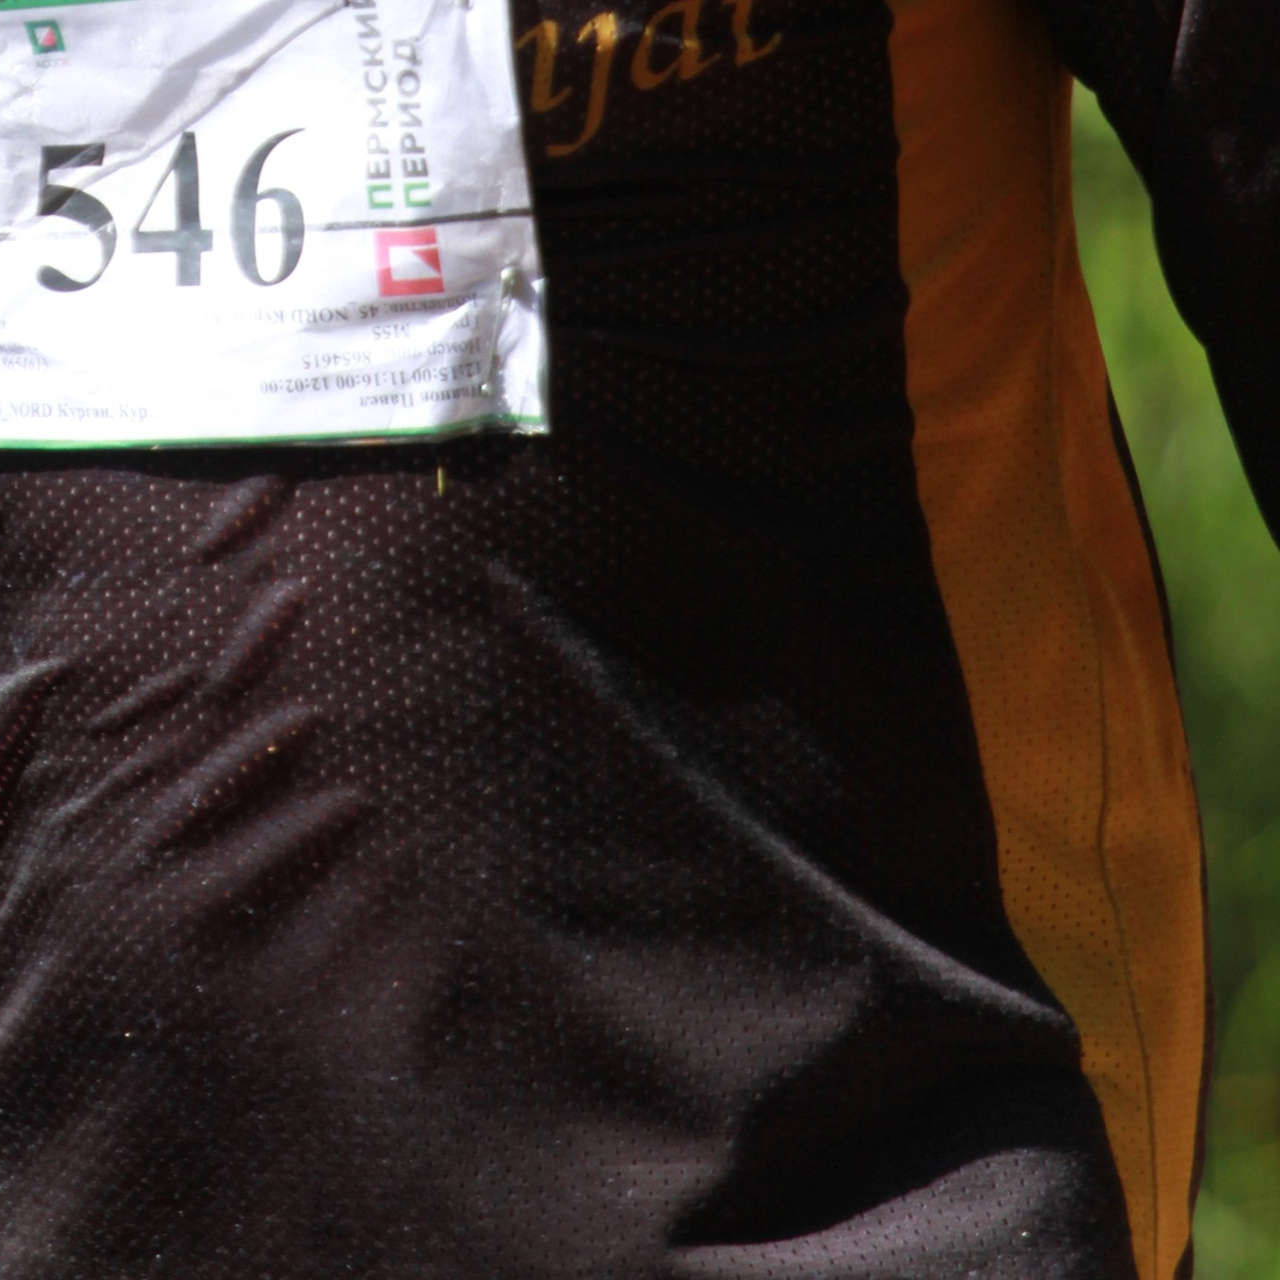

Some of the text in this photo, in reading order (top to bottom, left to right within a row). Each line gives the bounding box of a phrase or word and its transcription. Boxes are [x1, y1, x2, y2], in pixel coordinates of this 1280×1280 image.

[393, 38, 432, 209] ПЕРИОД
[36, 127, 306, 293] 546
[302, 350, 373, 370] 8654615
[260, 377, 330, 395] 12:02:00
[335, 370, 407, 390] 11:16:00
